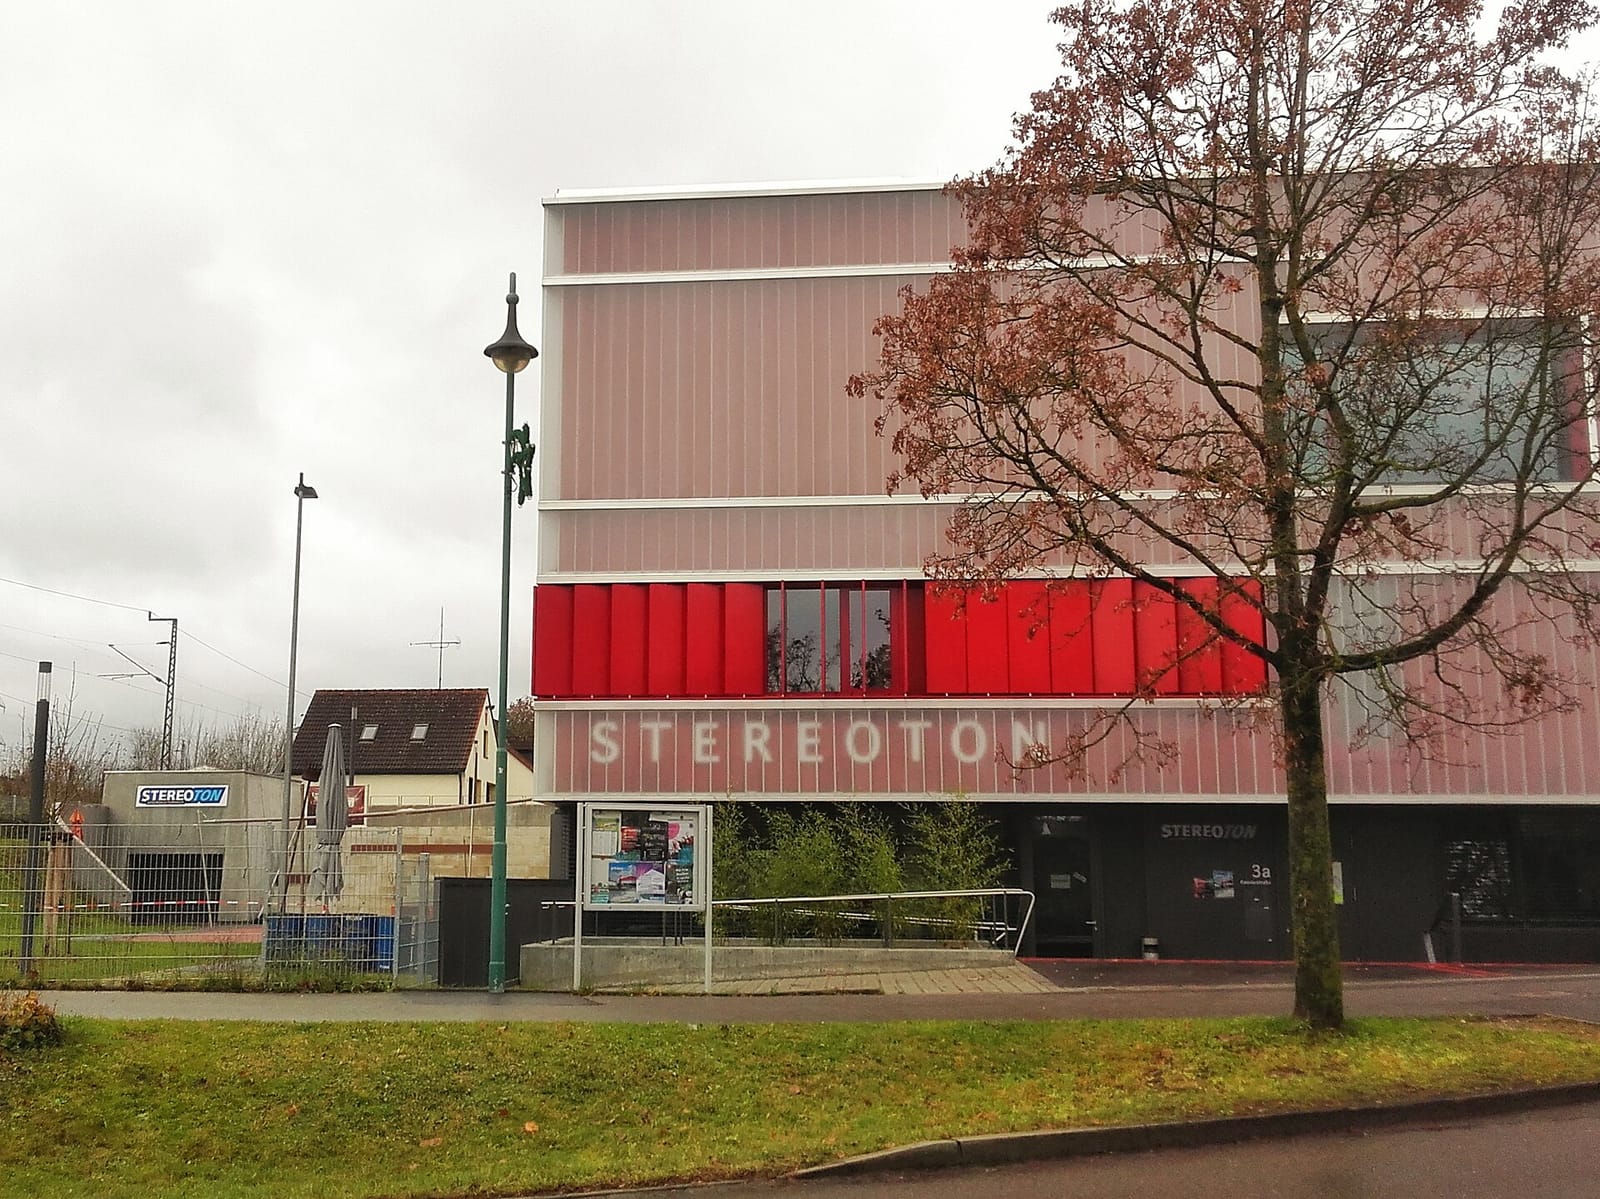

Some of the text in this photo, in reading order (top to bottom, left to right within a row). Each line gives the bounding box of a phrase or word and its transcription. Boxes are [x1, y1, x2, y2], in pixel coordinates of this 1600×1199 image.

[590, 720, 1047, 764] STEREOTON
[141, 790, 222, 802] STEREOTON
[1161, 824, 1257, 838] STEREOTON
[1251, 864, 1271, 879] 3a
